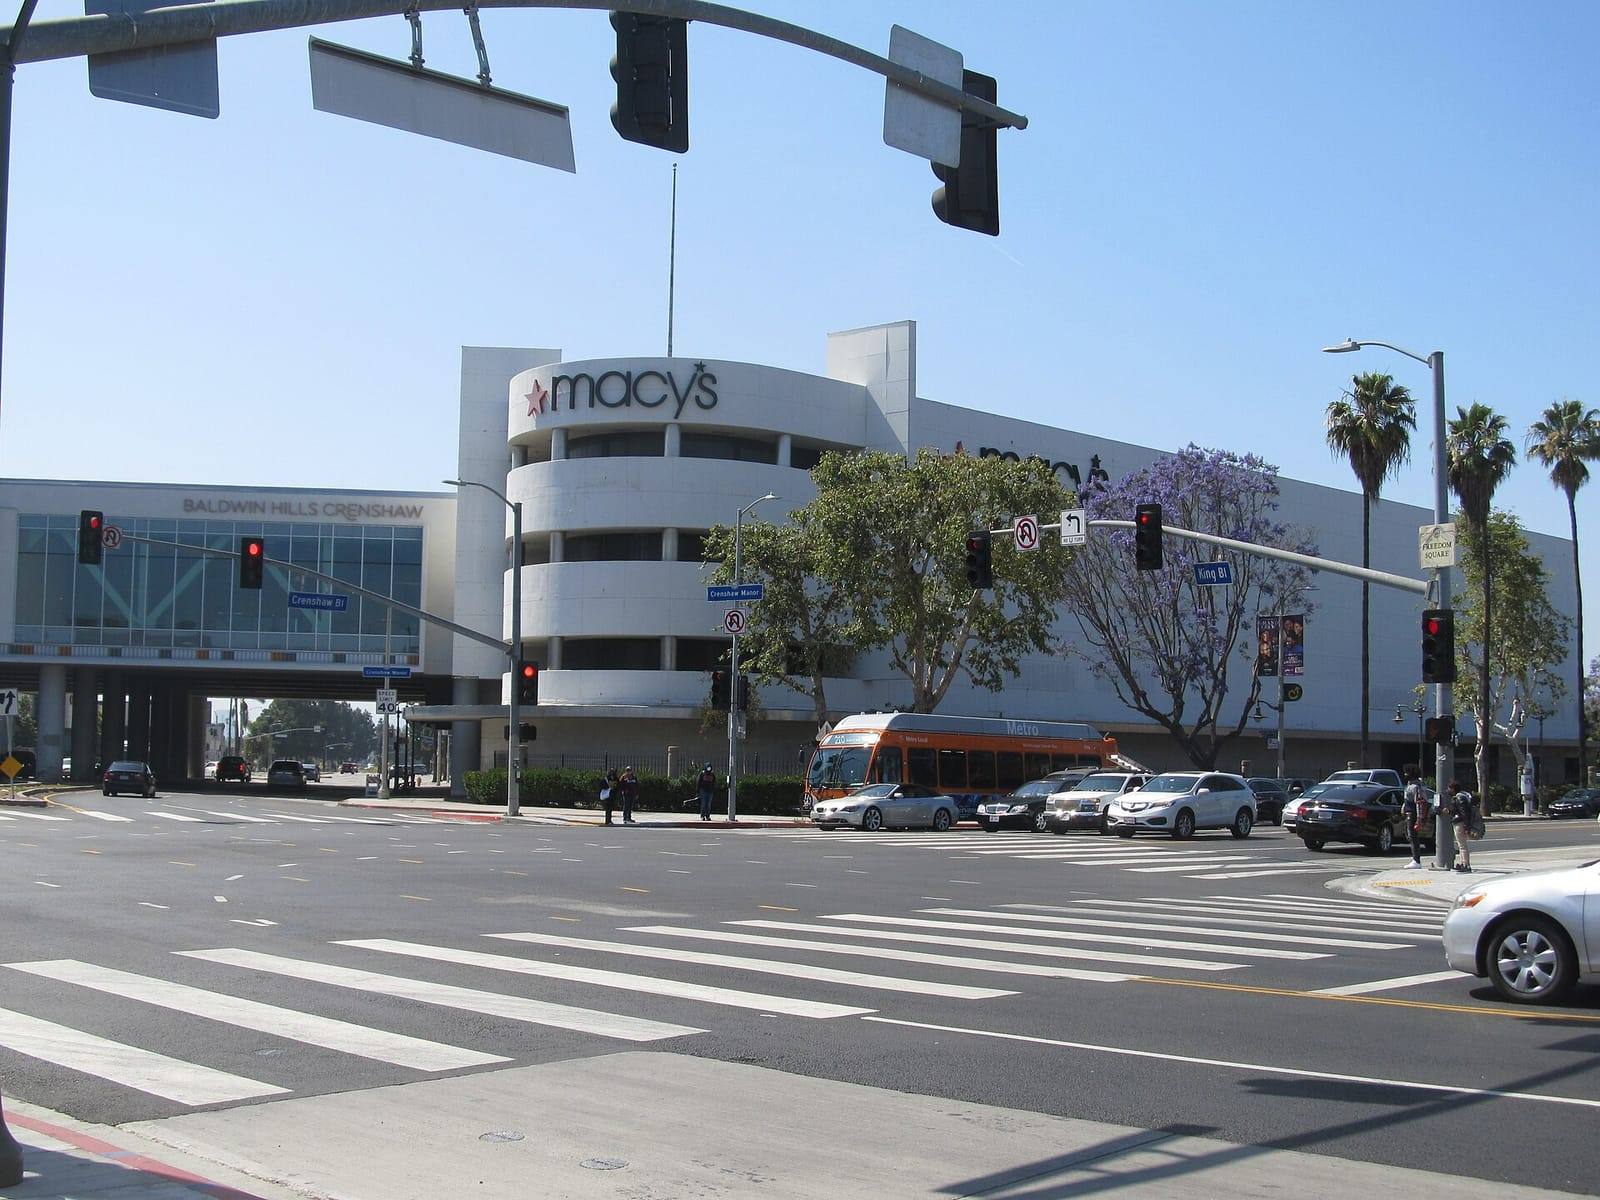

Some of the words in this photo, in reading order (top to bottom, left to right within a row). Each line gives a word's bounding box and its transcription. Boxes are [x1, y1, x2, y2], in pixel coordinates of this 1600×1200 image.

[183, 498, 266, 514] BALDWIN
[271, 502, 318, 516] HILLS
[322, 503, 424, 521] CRENSHAW
[1422, 541, 1452, 550] FREEDOM
[1424, 550, 1449, 559] SQUARE
[1198, 568, 1216, 583] King
[1217, 567, 1227, 578] Bl
[291, 594, 332, 606] Crenshaw
[377, 702, 395, 712] 40
[1006, 721, 1039, 736] Metro
